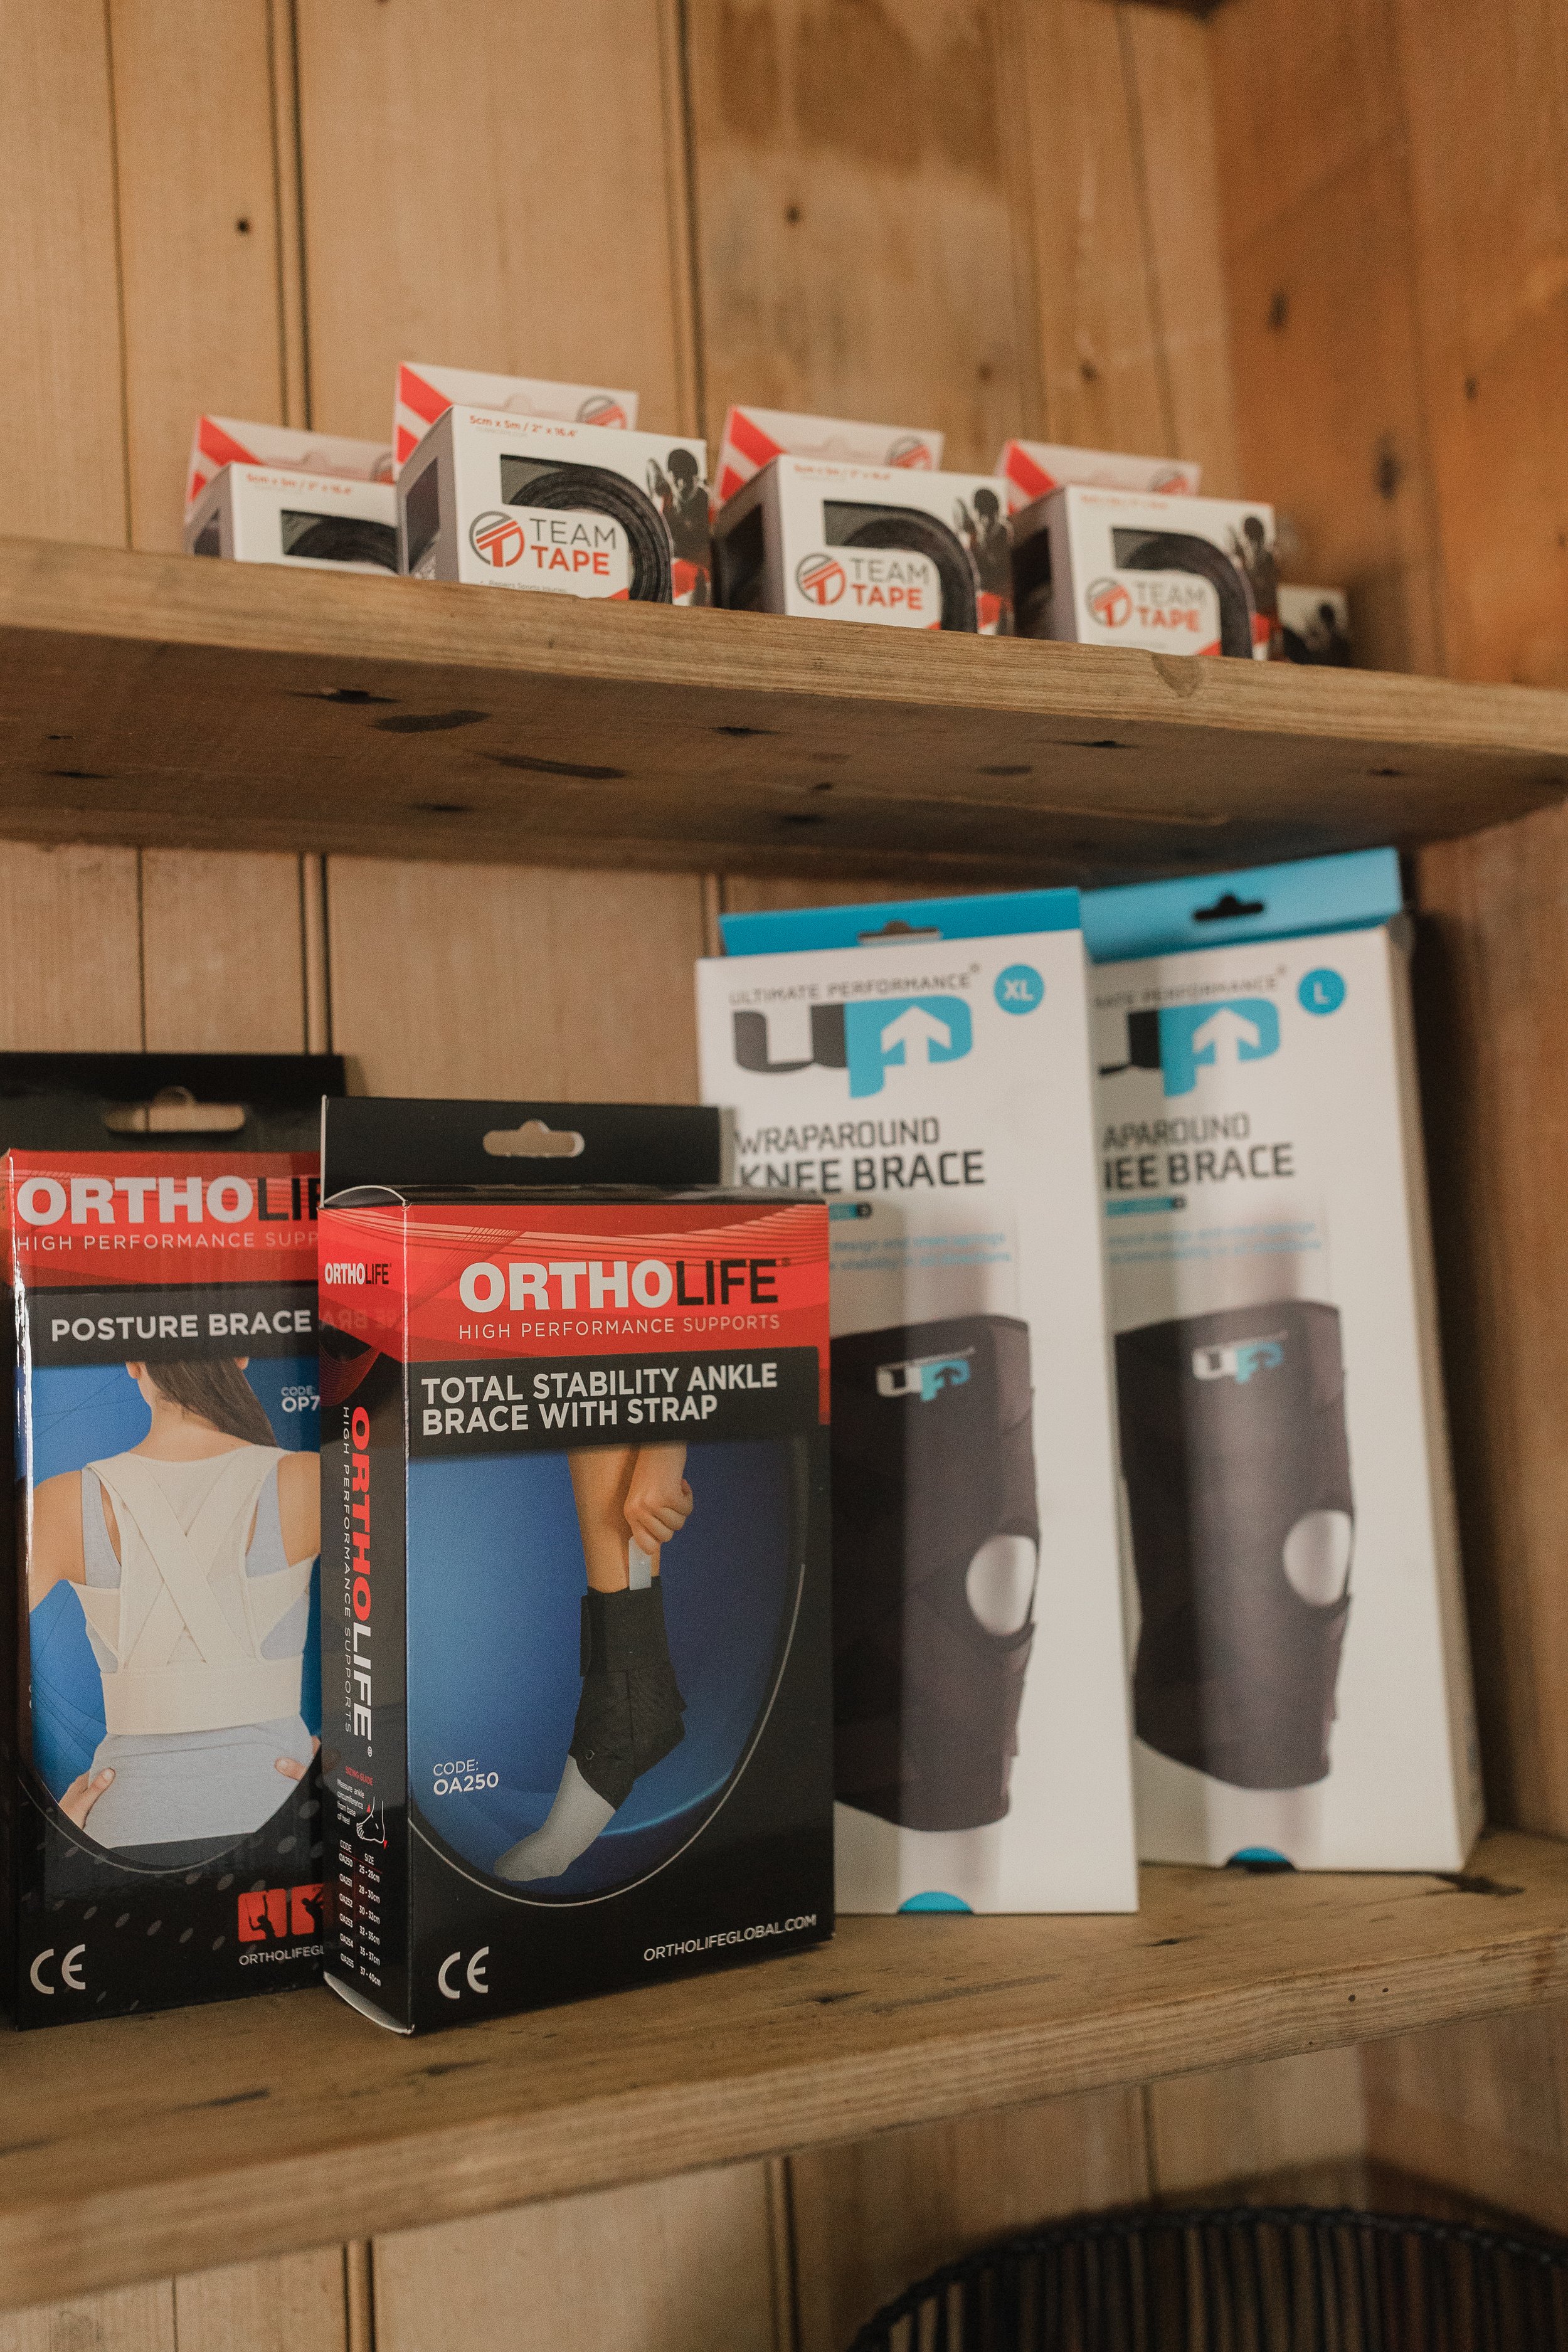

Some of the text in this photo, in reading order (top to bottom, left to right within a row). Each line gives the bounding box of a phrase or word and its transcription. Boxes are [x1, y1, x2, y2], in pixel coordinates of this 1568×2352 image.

[530, 517, 617, 549] TEAM
[531, 545, 610, 576] TAPE
[850, 556, 930, 585] TEAM
[851, 583, 923, 610] TAPE
[1133, 581, 1207, 609] TEAM
[1137, 607, 1202, 632] TAPE
[728, 983, 818, 1004] ULTIMATE
[1002, 980, 1034, 1002] XL
[1314, 981, 1330, 1004] L
[736, 1116, 939, 1155] WRAPAROUND
[739, 1149, 985, 1192] KNEE BRACE
[1105, 1142, 1295, 1192] EE BRACE
[17, 1235, 72, 1252] HIGH
[84, 1232, 254, 1251] PERFORMANCE
[51, 1309, 312, 1342] POSTURE BRACE
[459, 1313, 780, 1340] HIGH PERFORMANCE SUPPORTS
[421, 1362, 778, 1406] TOTAL STABILITY ANKLE
[282, 1395, 320, 1412] OP7
[421, 1394, 718, 1436] BRACE WITH STRAP
[343, 1463, 351, 1619] PERFORMANCE
[433, 1759, 479, 1777] CODE:
[433, 1771, 499, 1796] OA250
[364, 1853, 374, 1865] SIZE
[644, 1914, 817, 1962] ORTHOLIFEGLOBAL.COM
